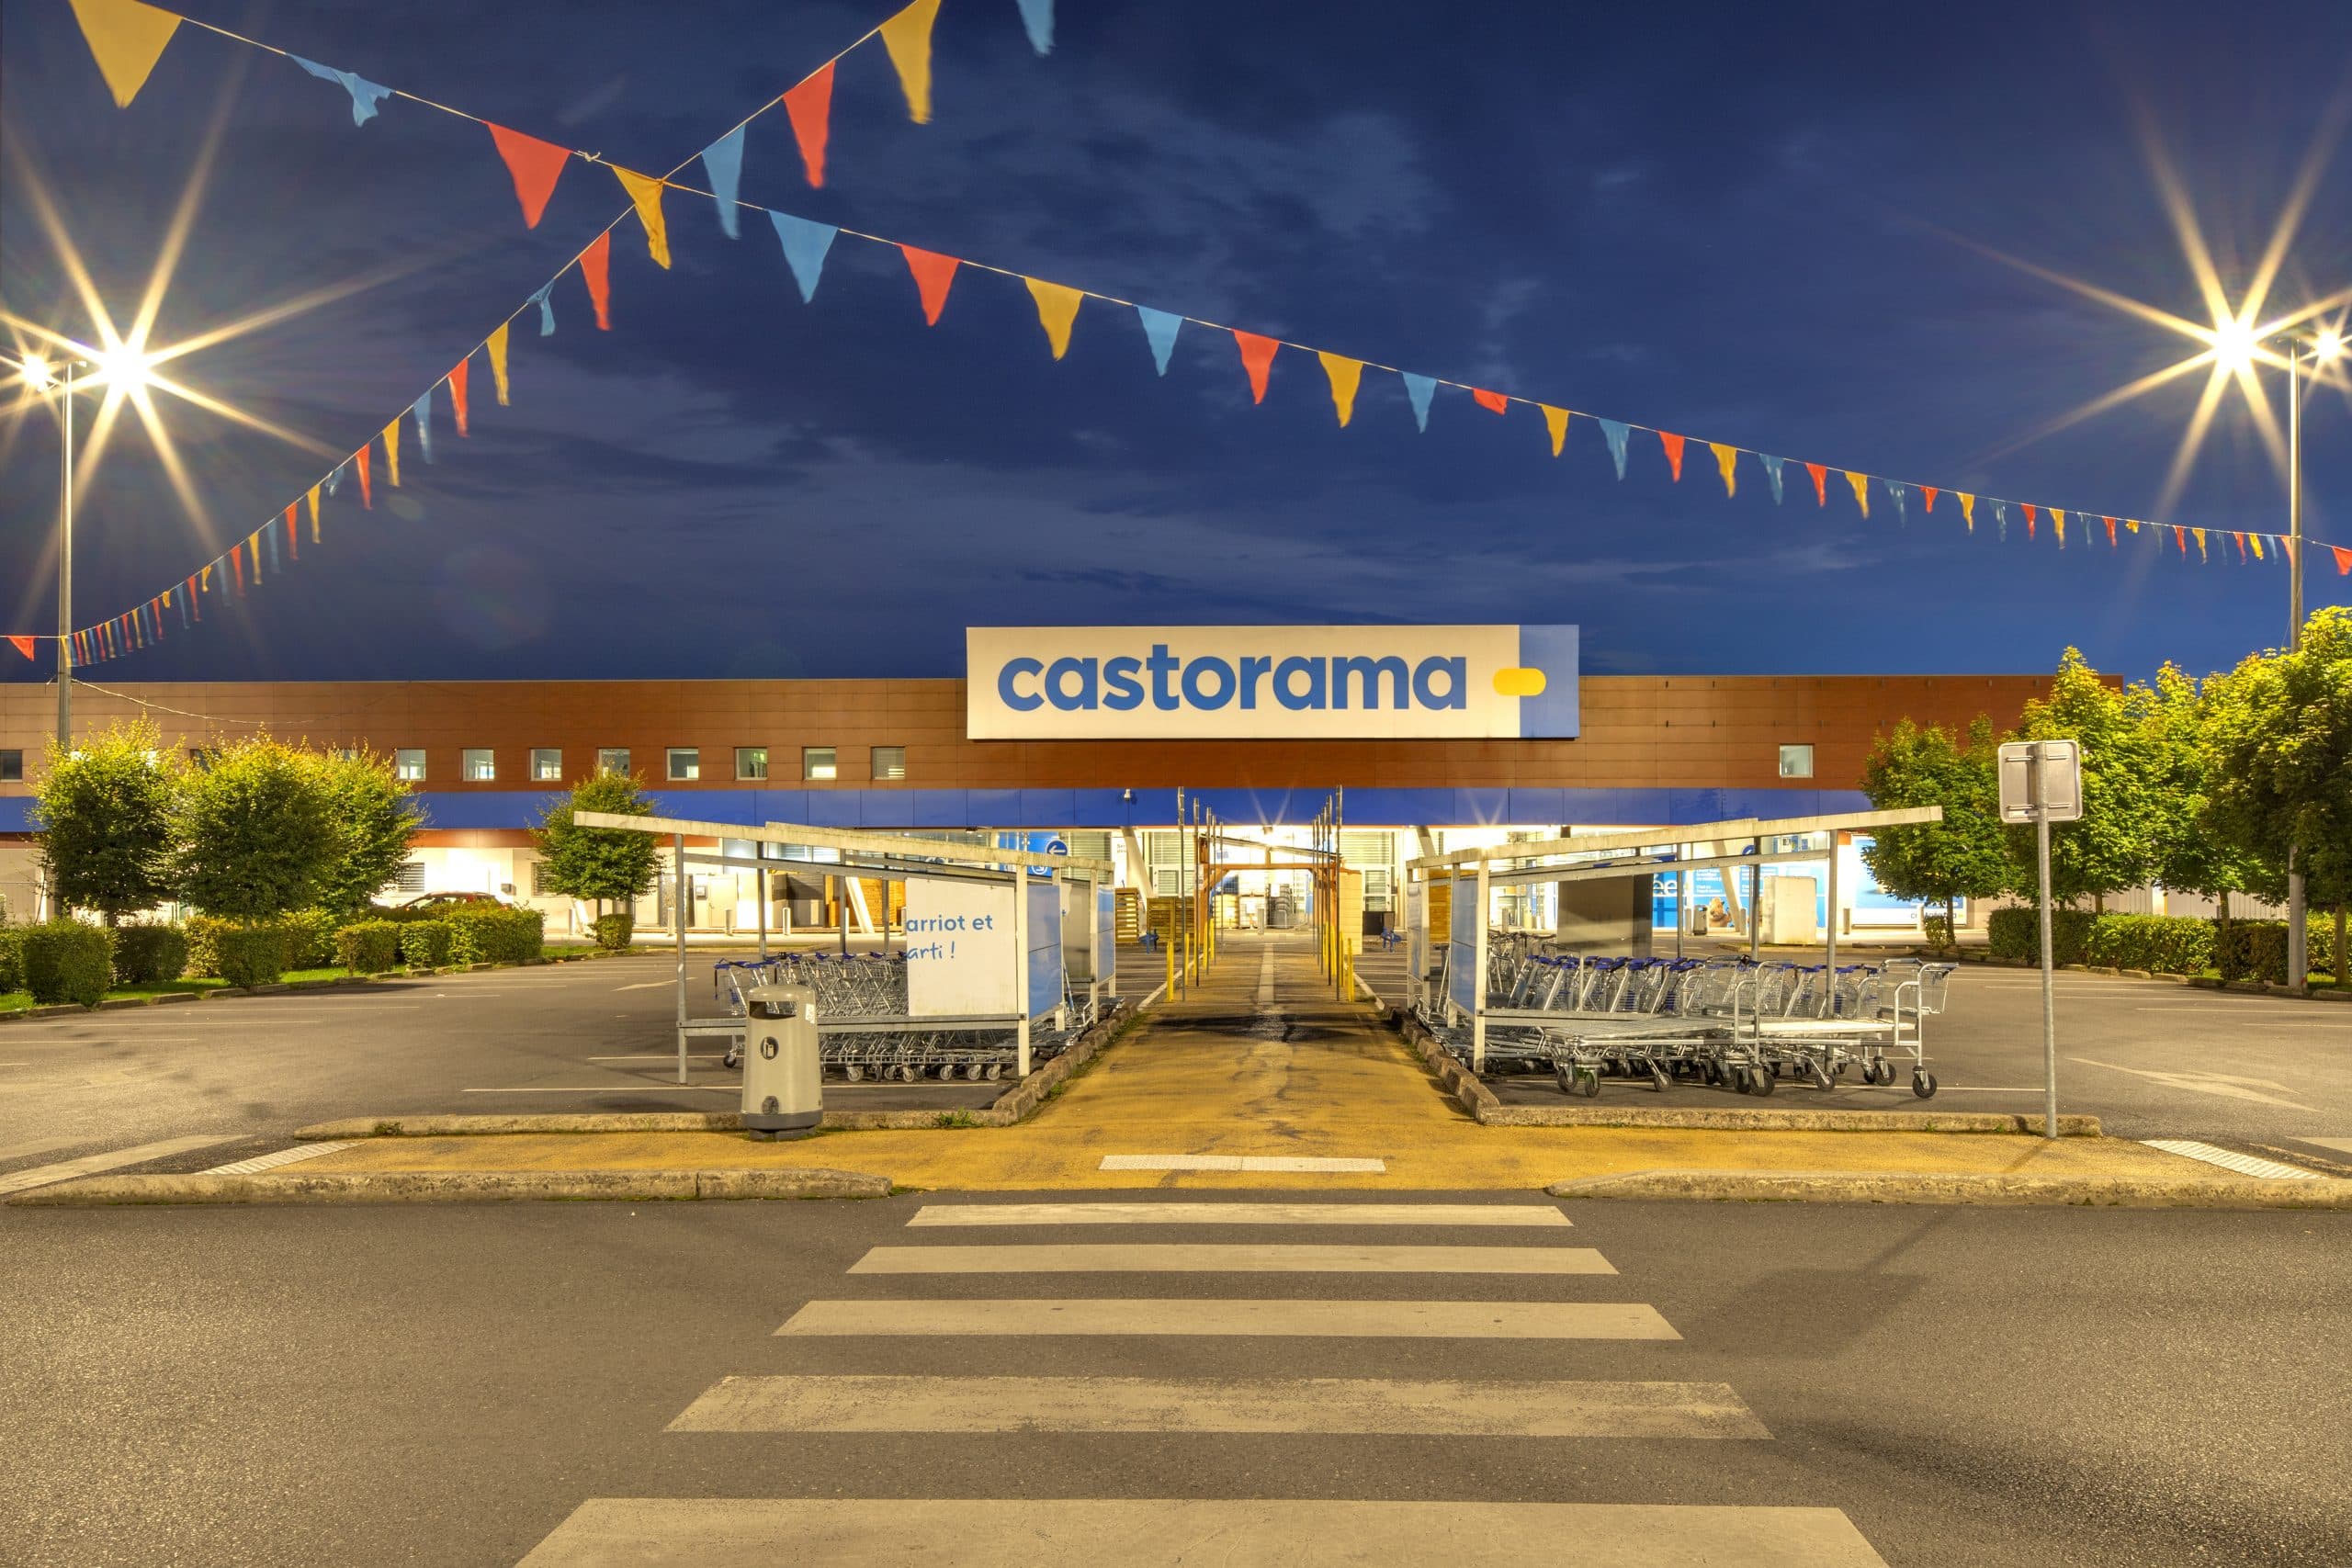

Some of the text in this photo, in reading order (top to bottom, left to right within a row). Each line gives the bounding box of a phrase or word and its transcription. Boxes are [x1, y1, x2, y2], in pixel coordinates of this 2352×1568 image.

[998, 644, 1466, 711] castorama
[906, 914, 993, 932] arriot et
